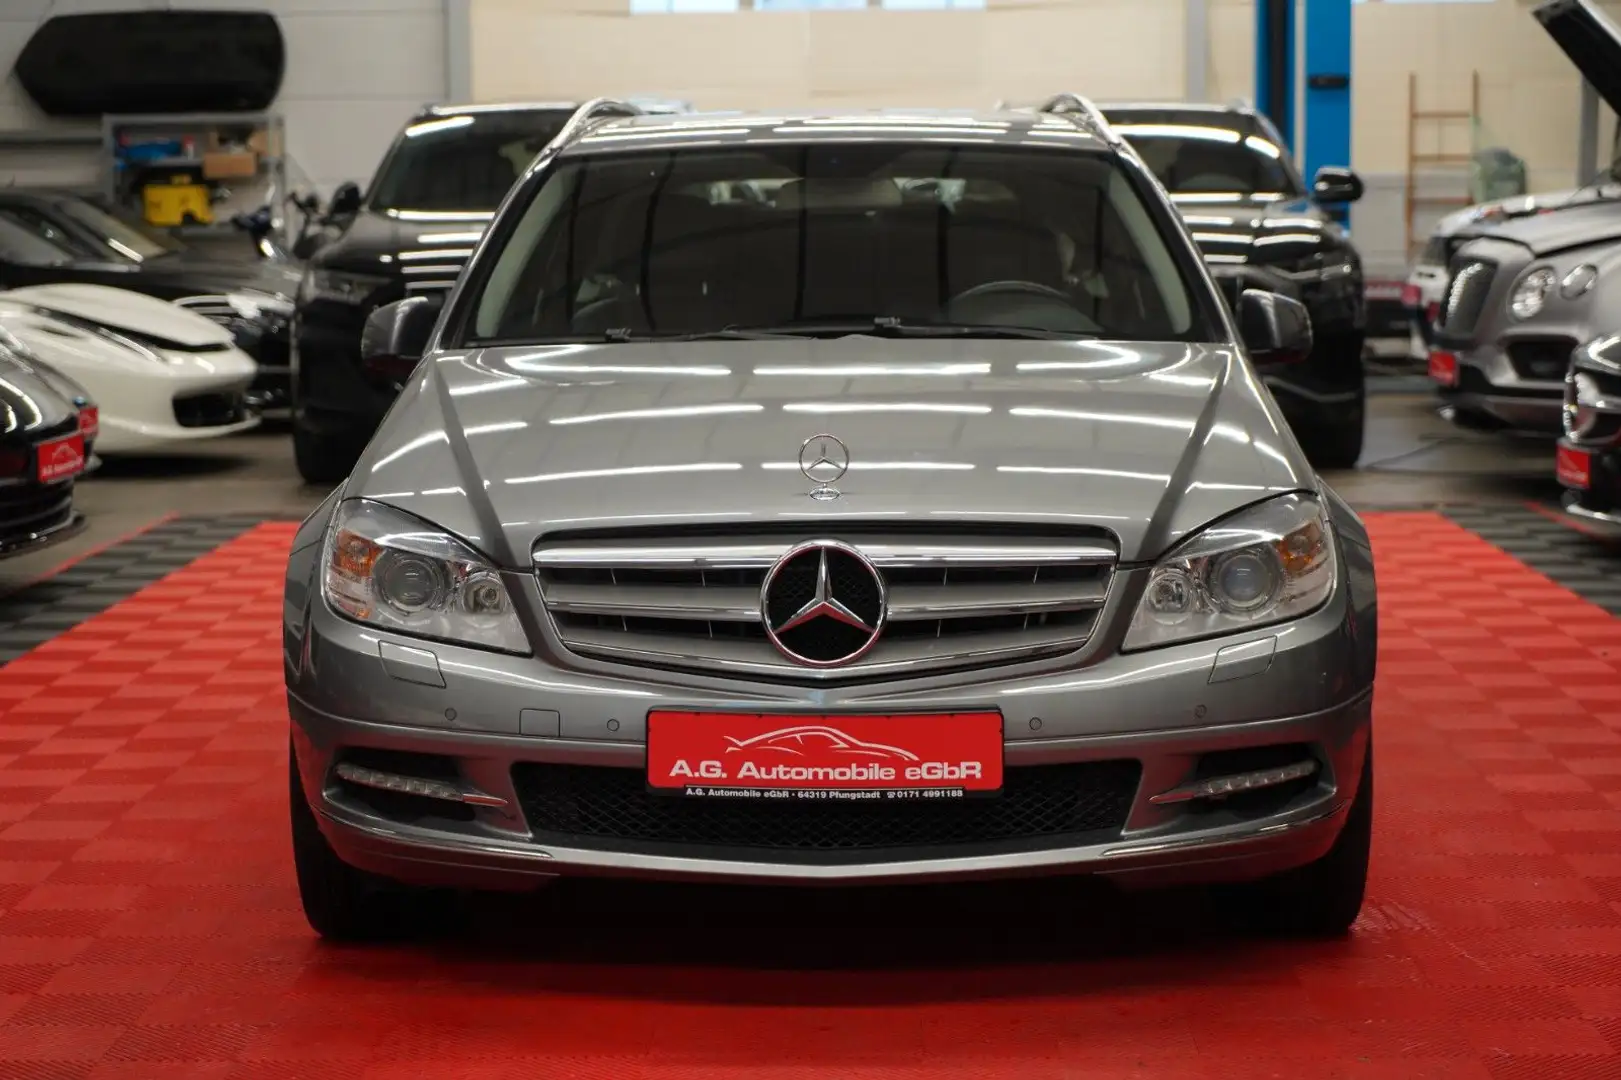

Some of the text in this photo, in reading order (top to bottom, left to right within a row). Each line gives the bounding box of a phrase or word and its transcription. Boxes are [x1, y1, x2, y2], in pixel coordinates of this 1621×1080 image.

[669, 759, 982, 781] A.G. Automobile eGbR
[686, 788, 706, 796] A.G.
[708, 788, 761, 798] Automobile
[763, 790, 789, 798] eGbR
[797, 790, 827, 799] 64319
[829, 790, 881, 800] Pfungstadt
